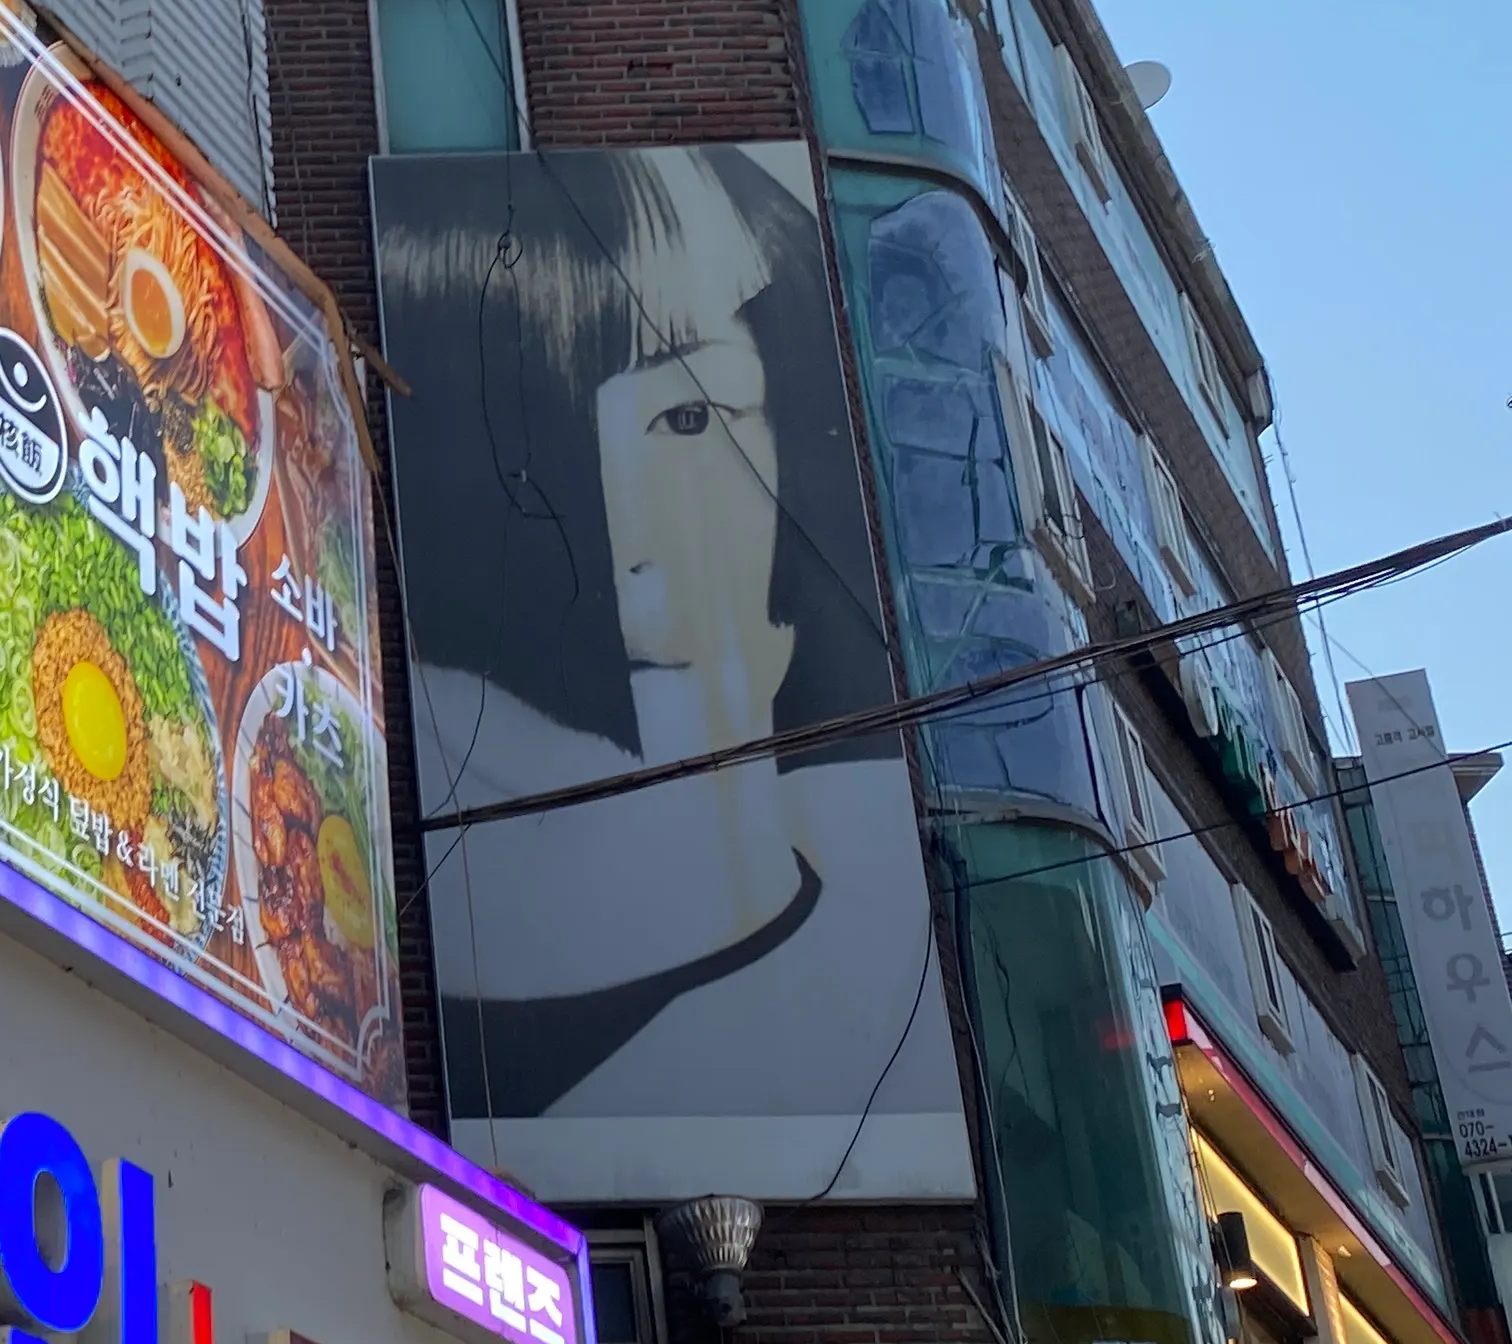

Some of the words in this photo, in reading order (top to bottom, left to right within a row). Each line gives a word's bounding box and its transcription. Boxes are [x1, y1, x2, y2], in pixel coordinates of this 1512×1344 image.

[77, 406, 249, 663] 핵밥
[270, 552, 338, 652] 소바
[274, 663, 345, 769] 카츠
[186, 880, 245, 946] 전문점
